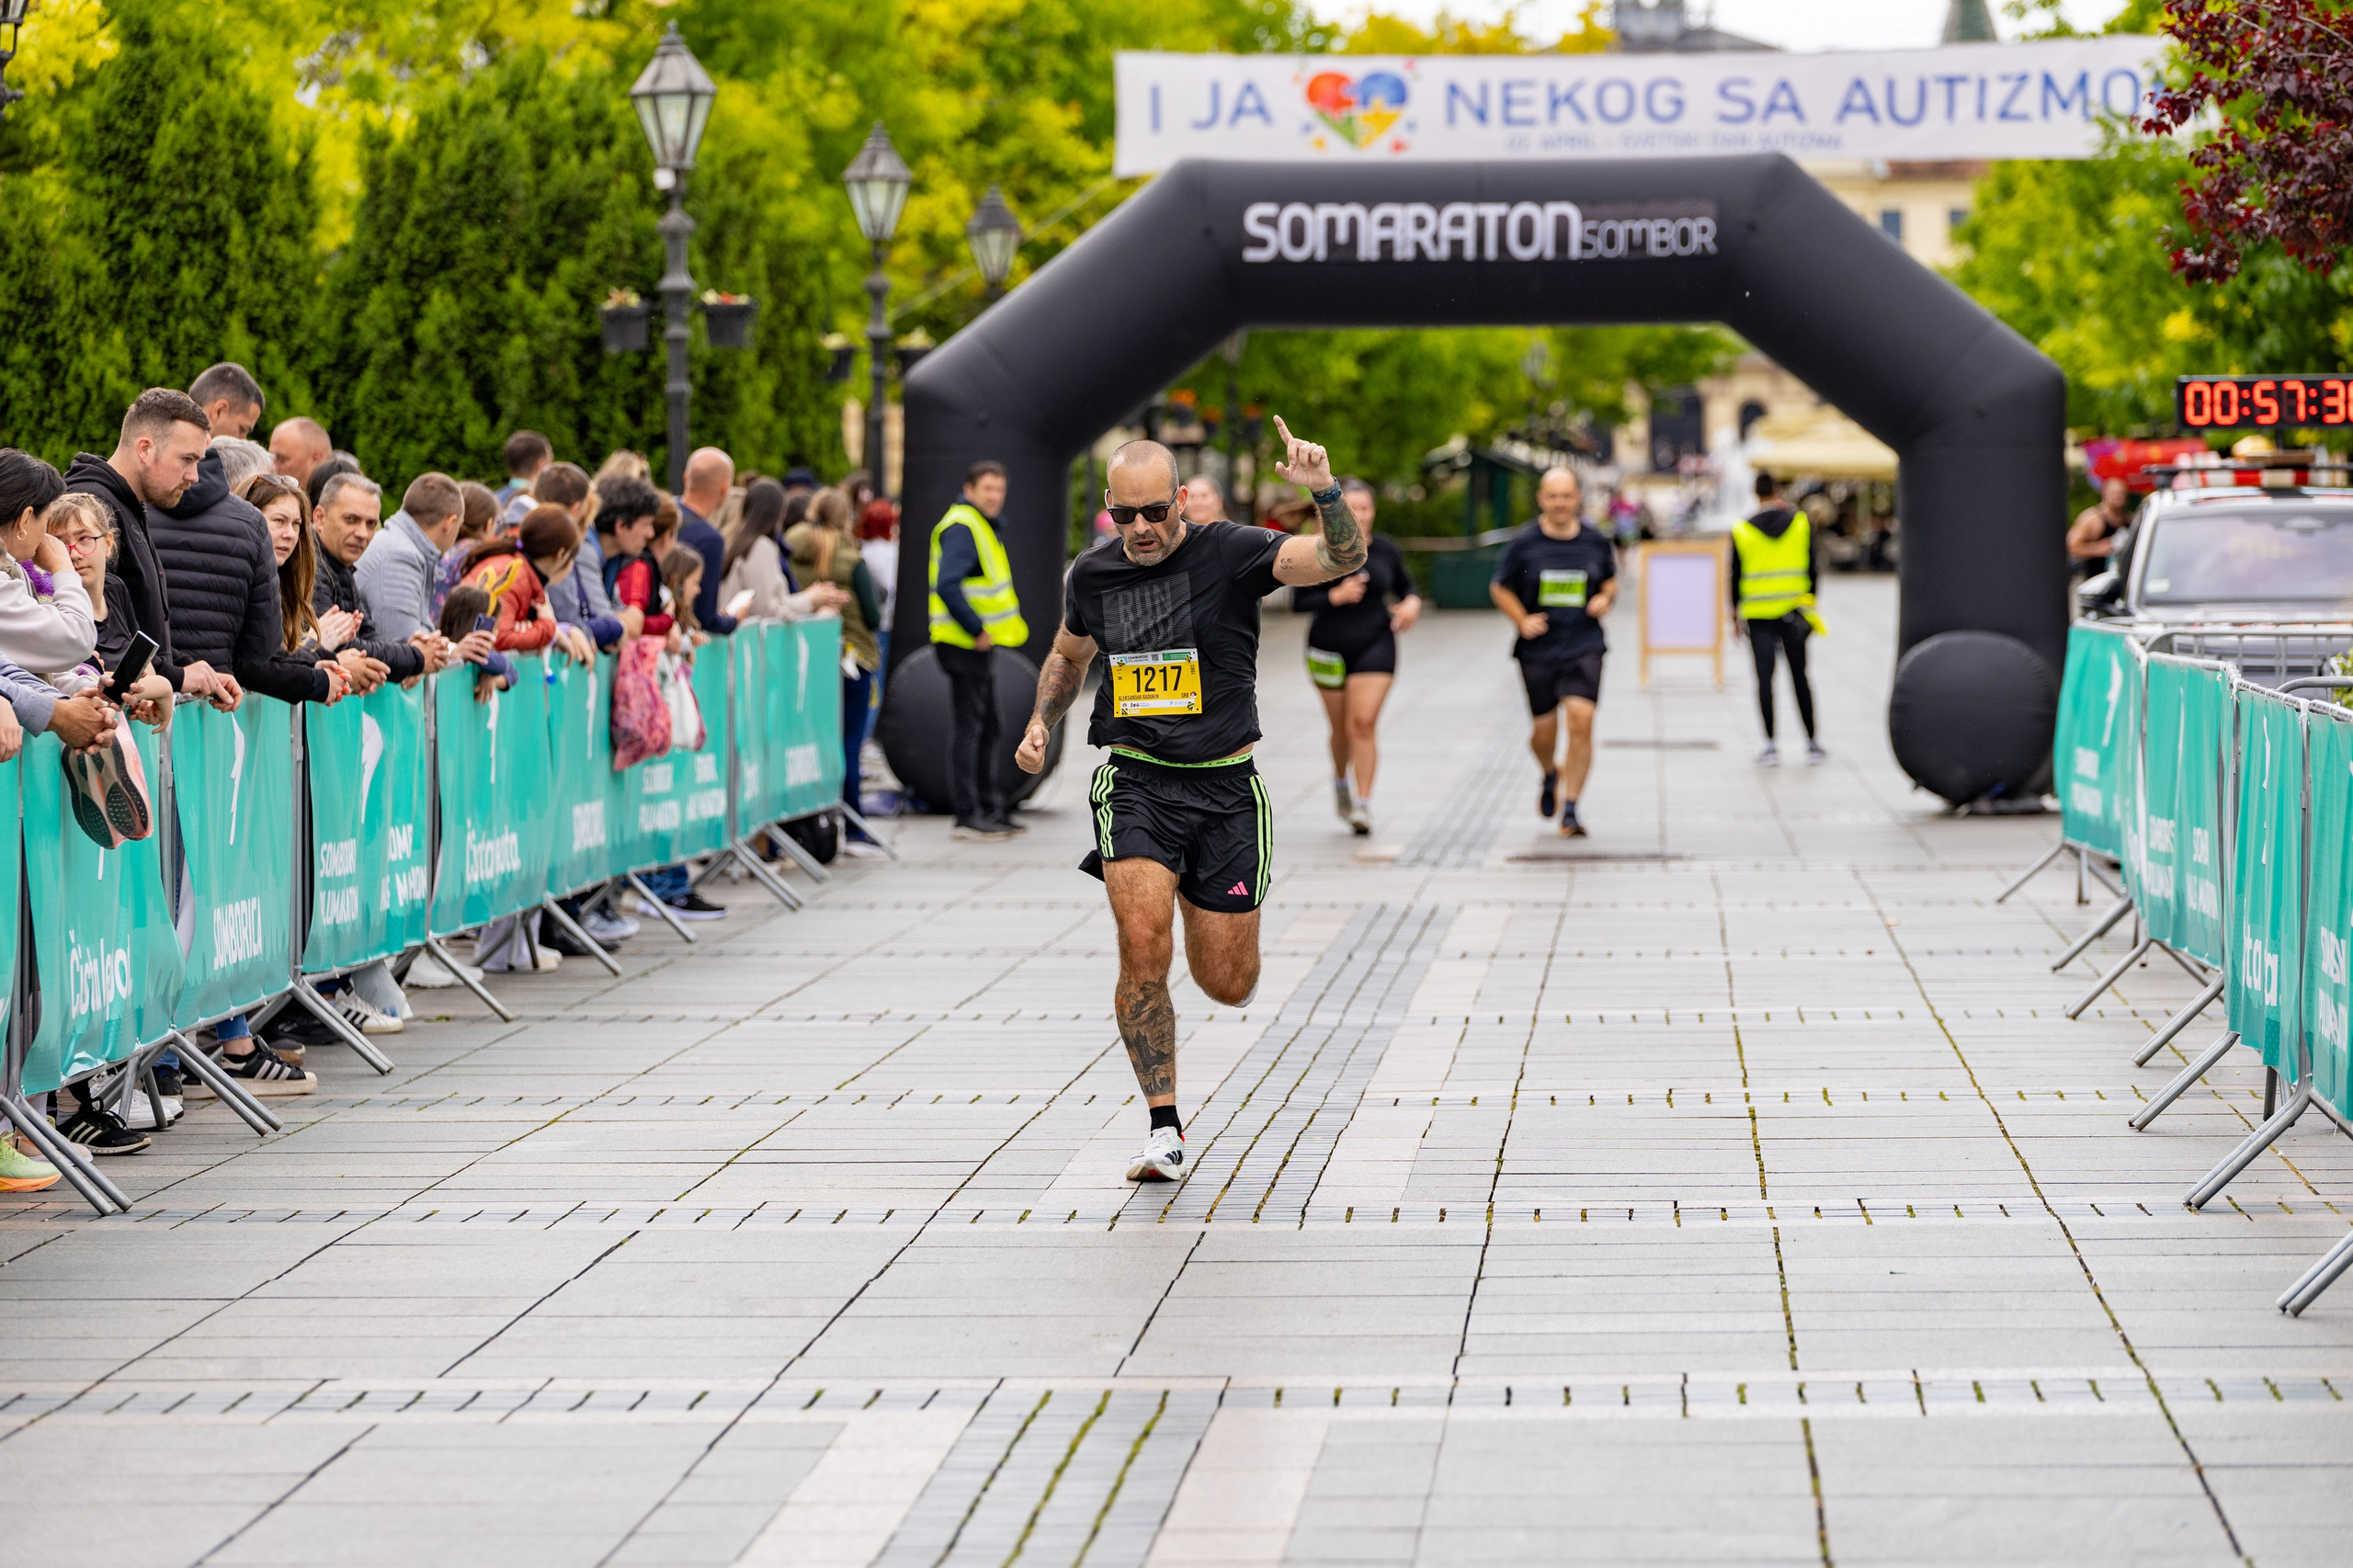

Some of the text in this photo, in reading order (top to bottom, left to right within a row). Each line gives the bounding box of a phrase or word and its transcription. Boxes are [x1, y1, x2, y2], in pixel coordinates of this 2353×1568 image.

[1150, 84, 1161, 132] I
[1190, 79, 1274, 130] JA
[1446, 76, 1687, 127] NEKOG
[1717, 77, 1806, 125] SA
[1242, 201, 1717, 263] SOMARATON SOMBOR
[2184, 379, 2353, 426] 00:57:3
[1132, 665, 1182, 693] 1217
[213, 895, 263, 971] SOMBORICA
